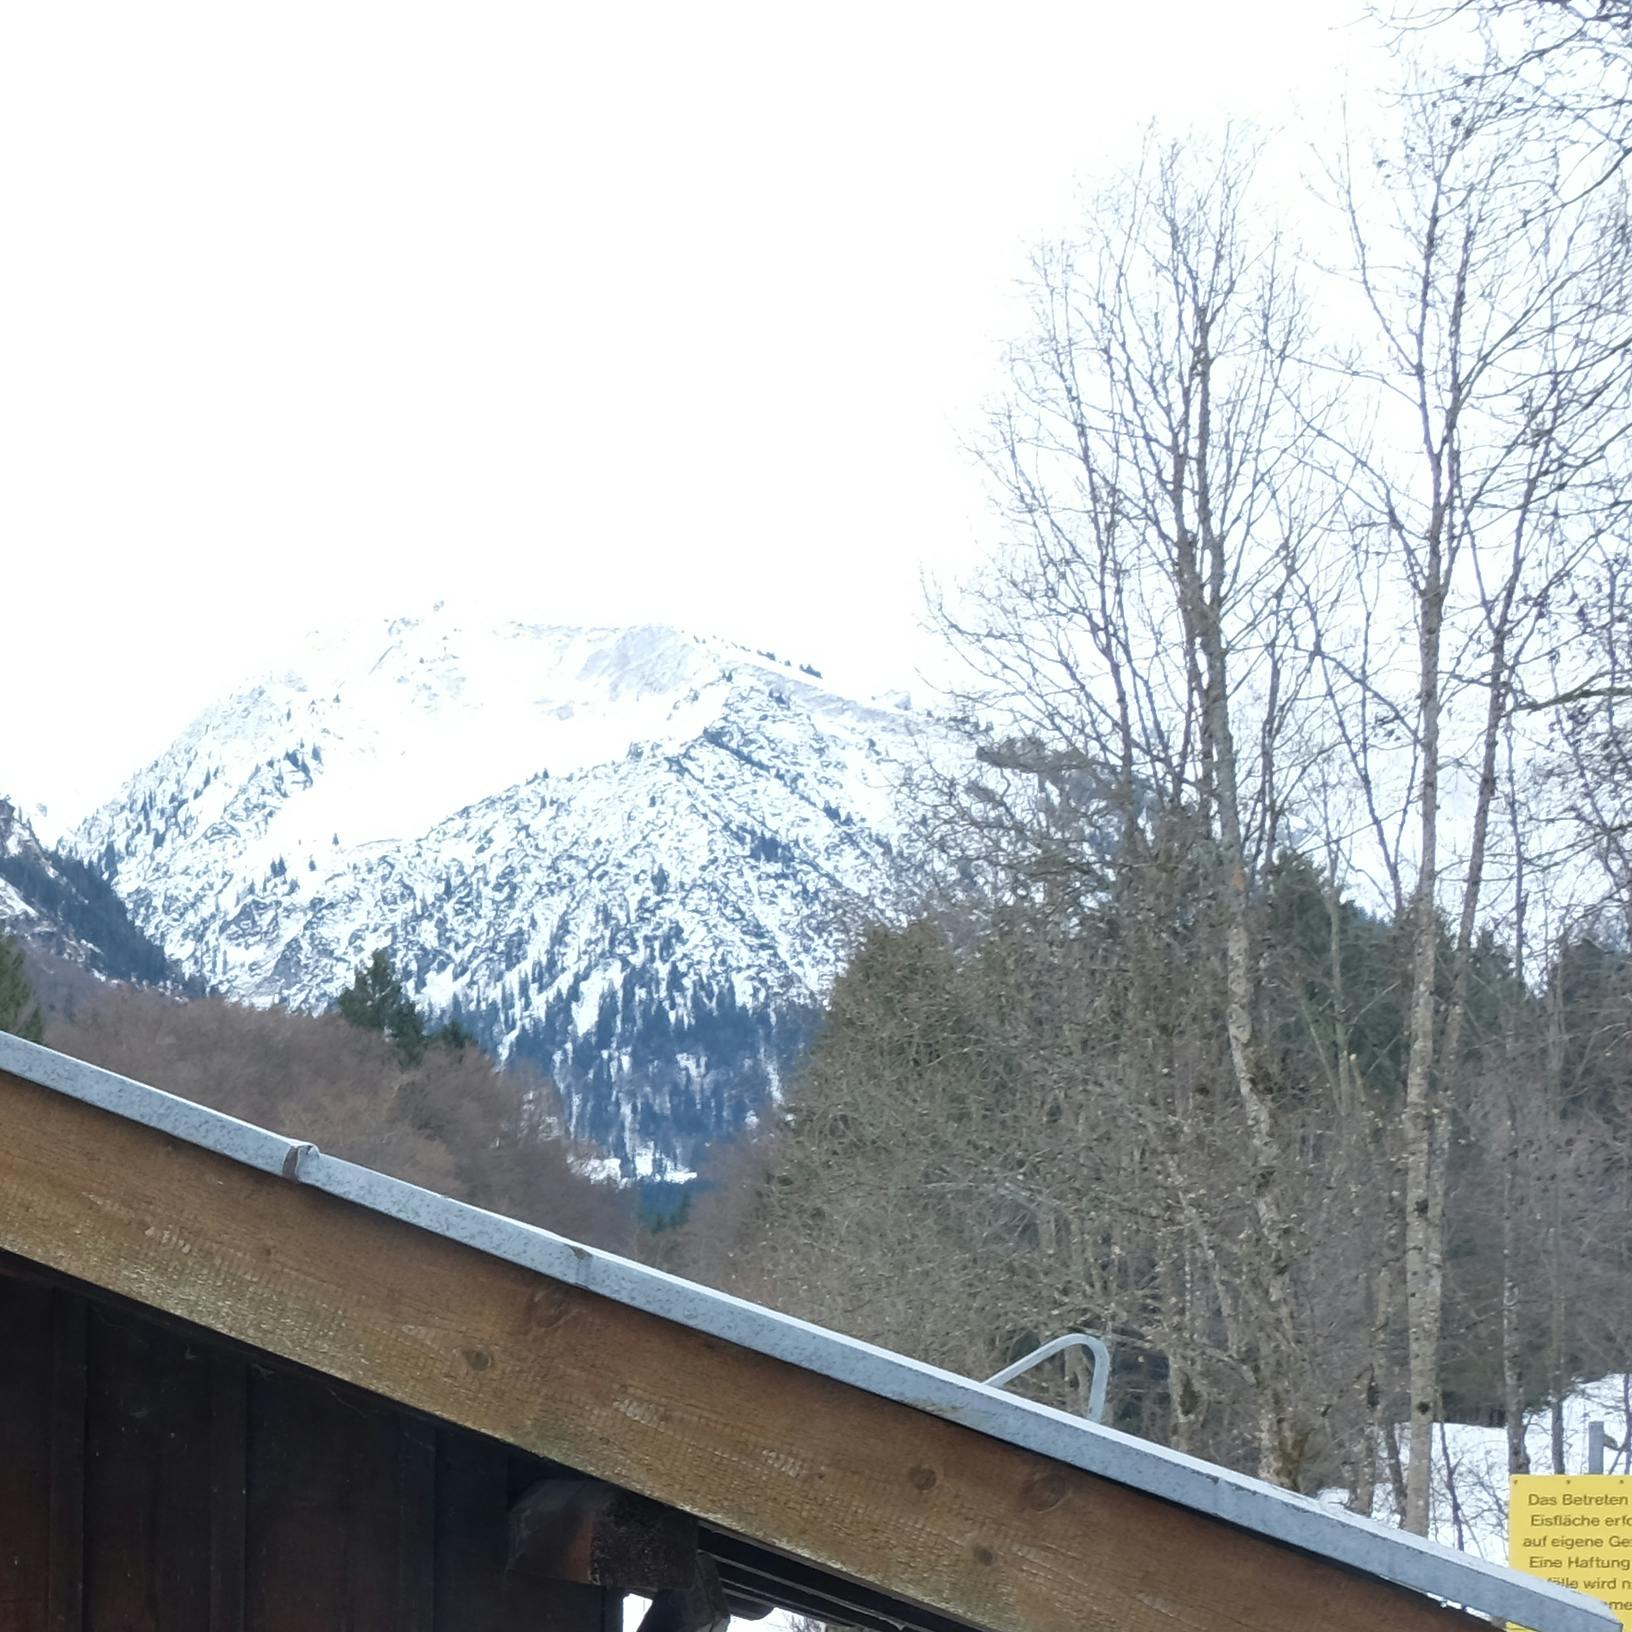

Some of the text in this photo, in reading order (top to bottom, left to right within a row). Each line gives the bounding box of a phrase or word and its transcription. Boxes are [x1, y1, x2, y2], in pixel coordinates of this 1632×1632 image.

[1528, 1493, 1629, 1506] Das Betreten
[1531, 1514, 1601, 1527] Eisfläche
[1523, 1535, 1548, 1549] auf
[1551, 1535, 1604, 1551] eigene
[1529, 1556, 1631, 1571] Eine Haftung
[1583, 1577, 1617, 1589] wird
